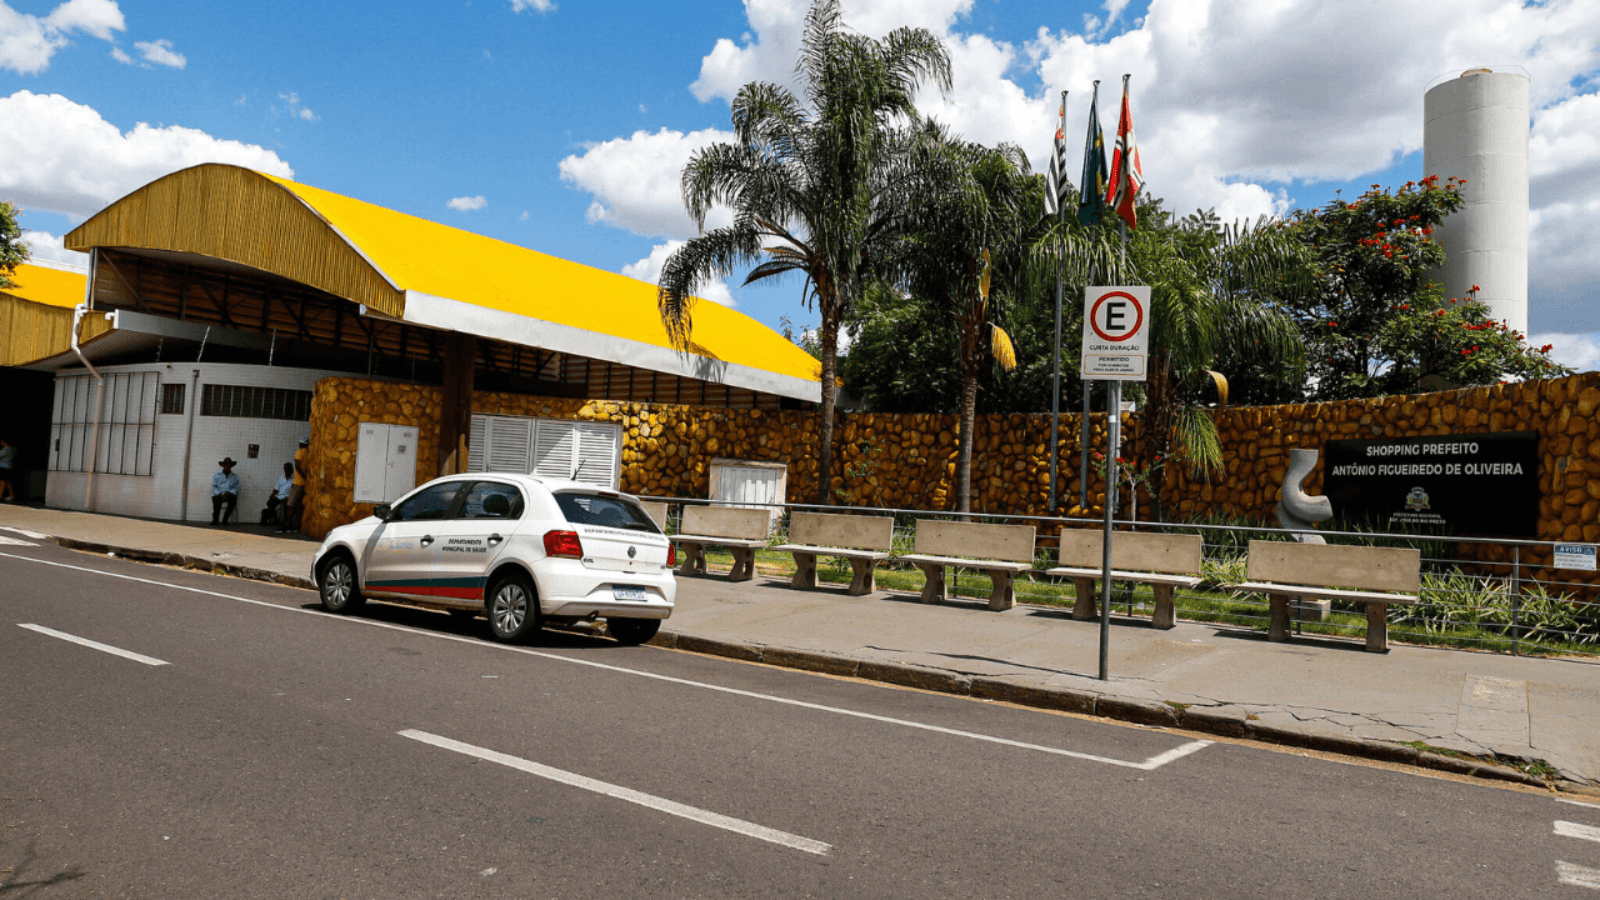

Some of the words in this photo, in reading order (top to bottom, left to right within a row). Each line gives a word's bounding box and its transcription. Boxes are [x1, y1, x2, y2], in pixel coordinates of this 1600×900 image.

[1106, 302, 1126, 330] E
[1109, 344, 1140, 352] DURAÇÃO
[1366, 444, 1420, 456] SHOPPING
[1422, 442, 1479, 455] PREFEITO
[1332, 462, 1376, 476] ANTÔNIO
[1378, 464, 1443, 476] FIGUEIREDO
[1445, 463, 1462, 475] DE
[1464, 463, 1523, 475] OLIVEIRA
